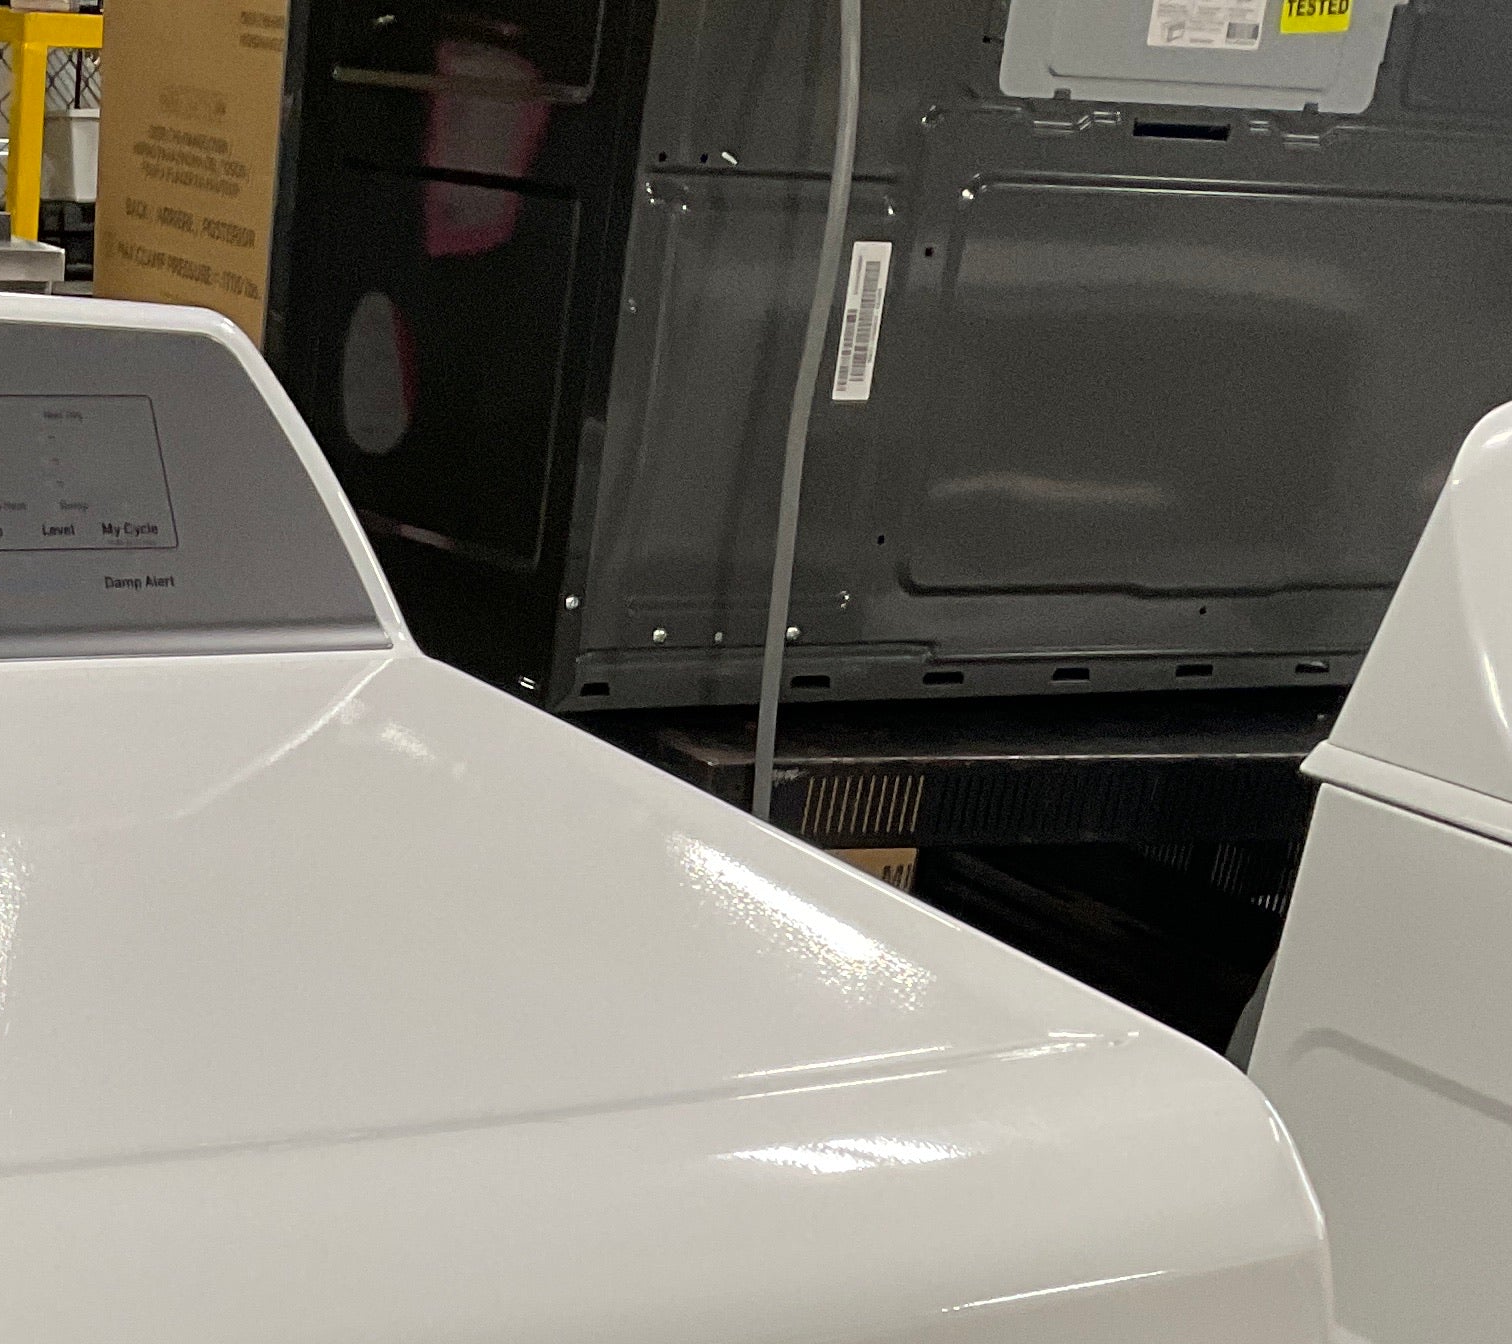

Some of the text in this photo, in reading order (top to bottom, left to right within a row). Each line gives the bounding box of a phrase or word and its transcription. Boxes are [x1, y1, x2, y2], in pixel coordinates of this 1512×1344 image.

[1287, 0, 1348, 16] TESTED
[42, 523, 76, 536] Level
[101, 521, 158, 537] My Cycle
[104, 574, 175, 590] Damp Alert
